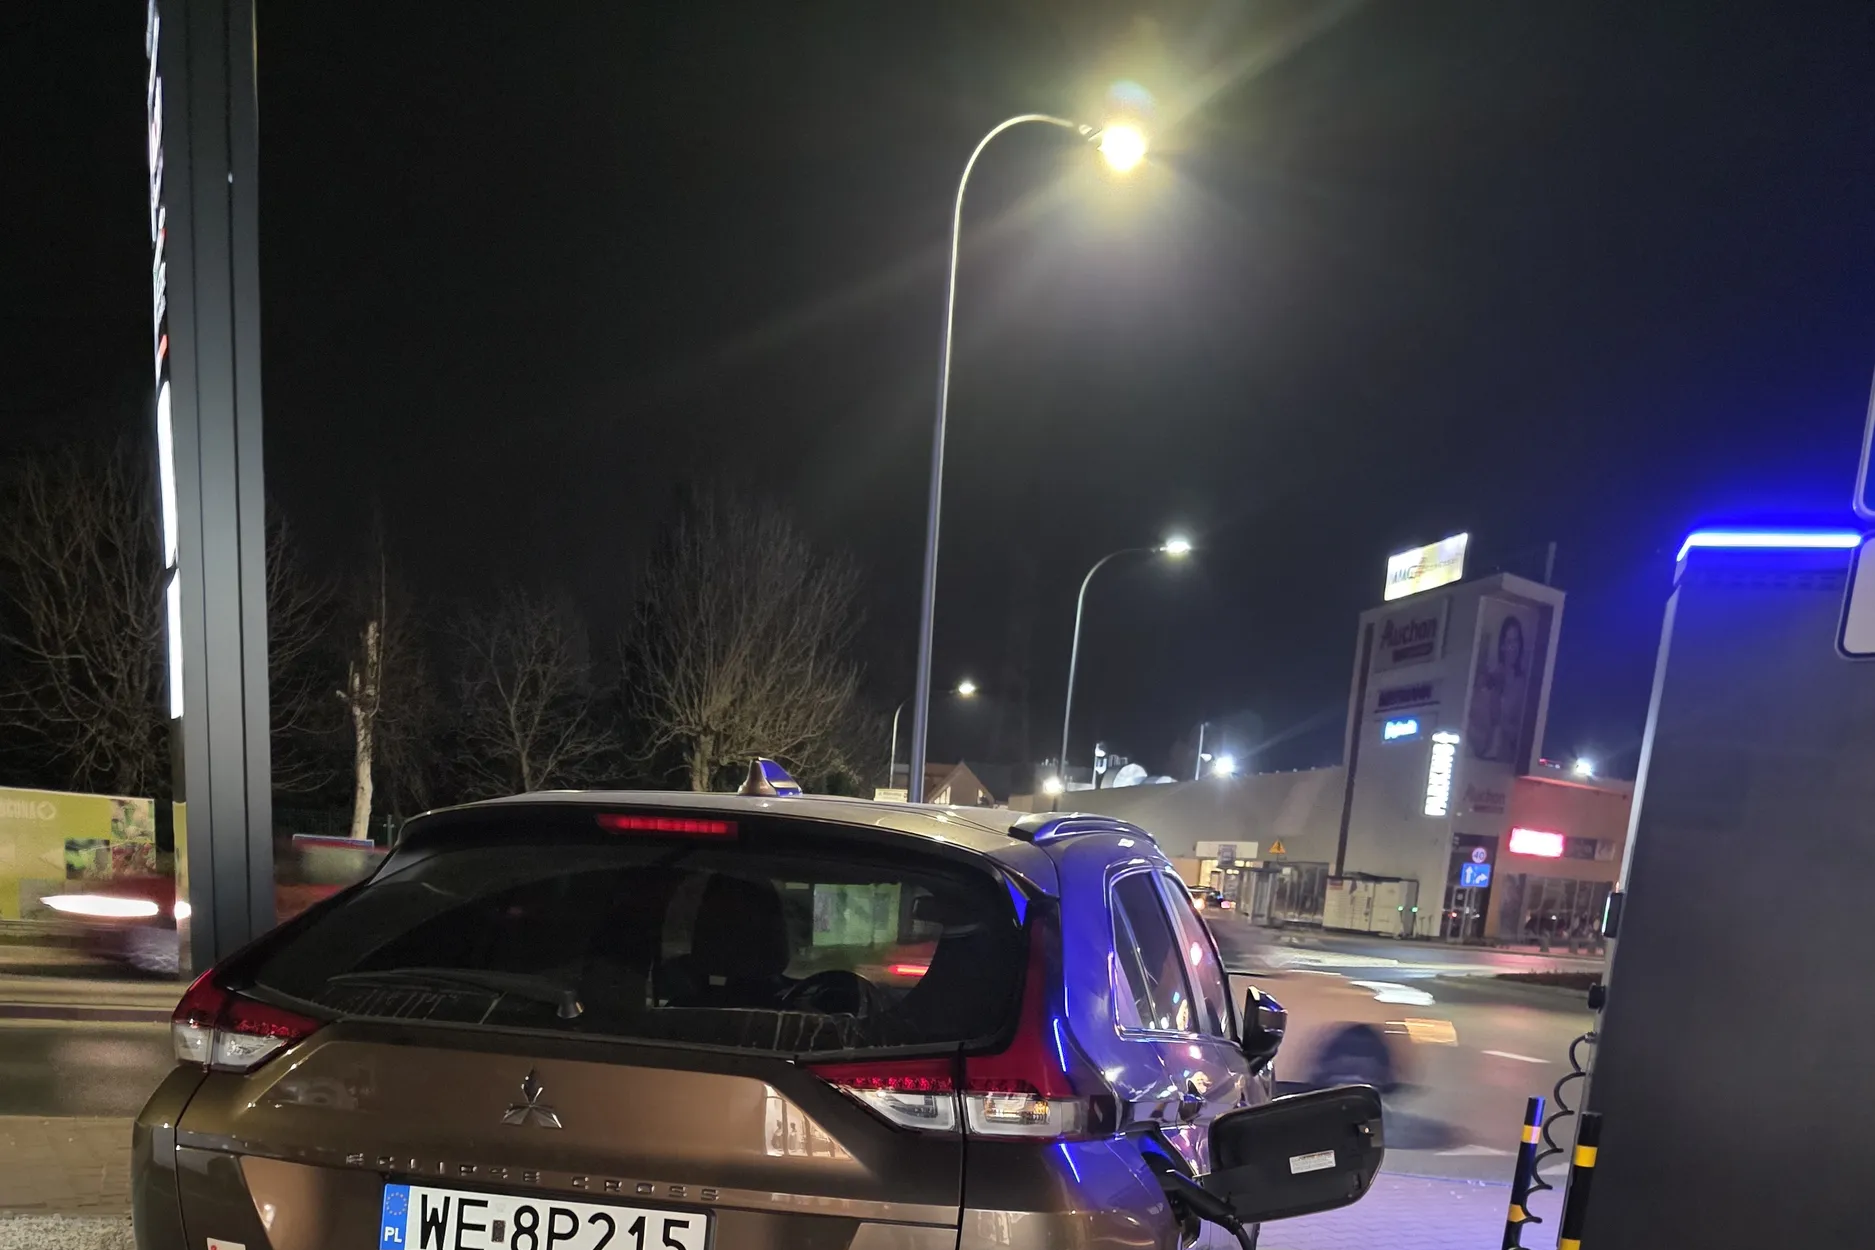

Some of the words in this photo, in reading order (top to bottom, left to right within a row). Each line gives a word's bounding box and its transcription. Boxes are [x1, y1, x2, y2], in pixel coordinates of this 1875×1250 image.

[1380, 615, 1437, 649] Auchan
[1474, 851, 1485, 860] 40
[346, 1153, 541, 1183] ECLIPSE
[571, 1175, 721, 1203] CROSS
[384, 1226, 402, 1244] PL
